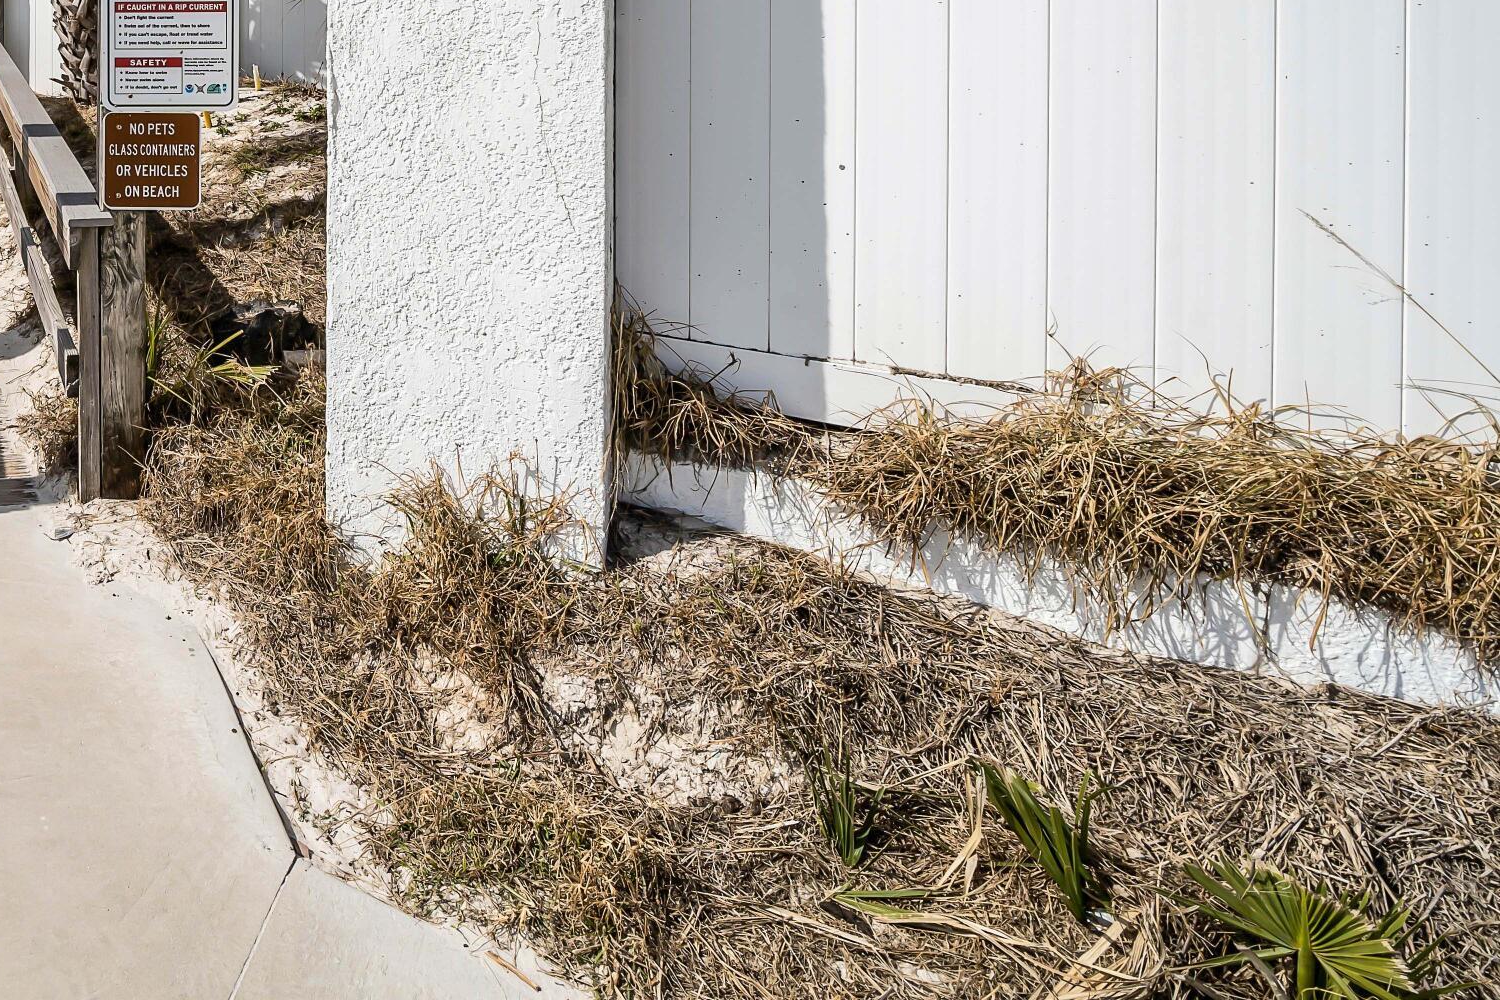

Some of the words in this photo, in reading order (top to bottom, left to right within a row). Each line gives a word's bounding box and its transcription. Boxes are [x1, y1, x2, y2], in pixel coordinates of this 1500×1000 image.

[118, 3, 124, 11] IF
[126, 3, 157, 11] CAUGHT
[158, 3, 166, 11] IN
[167, 3, 174, 11] A
[175, 3, 187, 11] RIP
[188, 3, 224, 11] CURRENT
[129, 123, 145, 135] NO
[147, 123, 175, 135] PETS
[109, 144, 138, 156] GLASS
[140, 144, 195, 156] CONTAINERS
[116, 164, 131, 177] OR
[134, 164, 188, 177] VEHICLES
[124, 185, 140, 198] ON
[142, 185, 179, 198] BEACH
